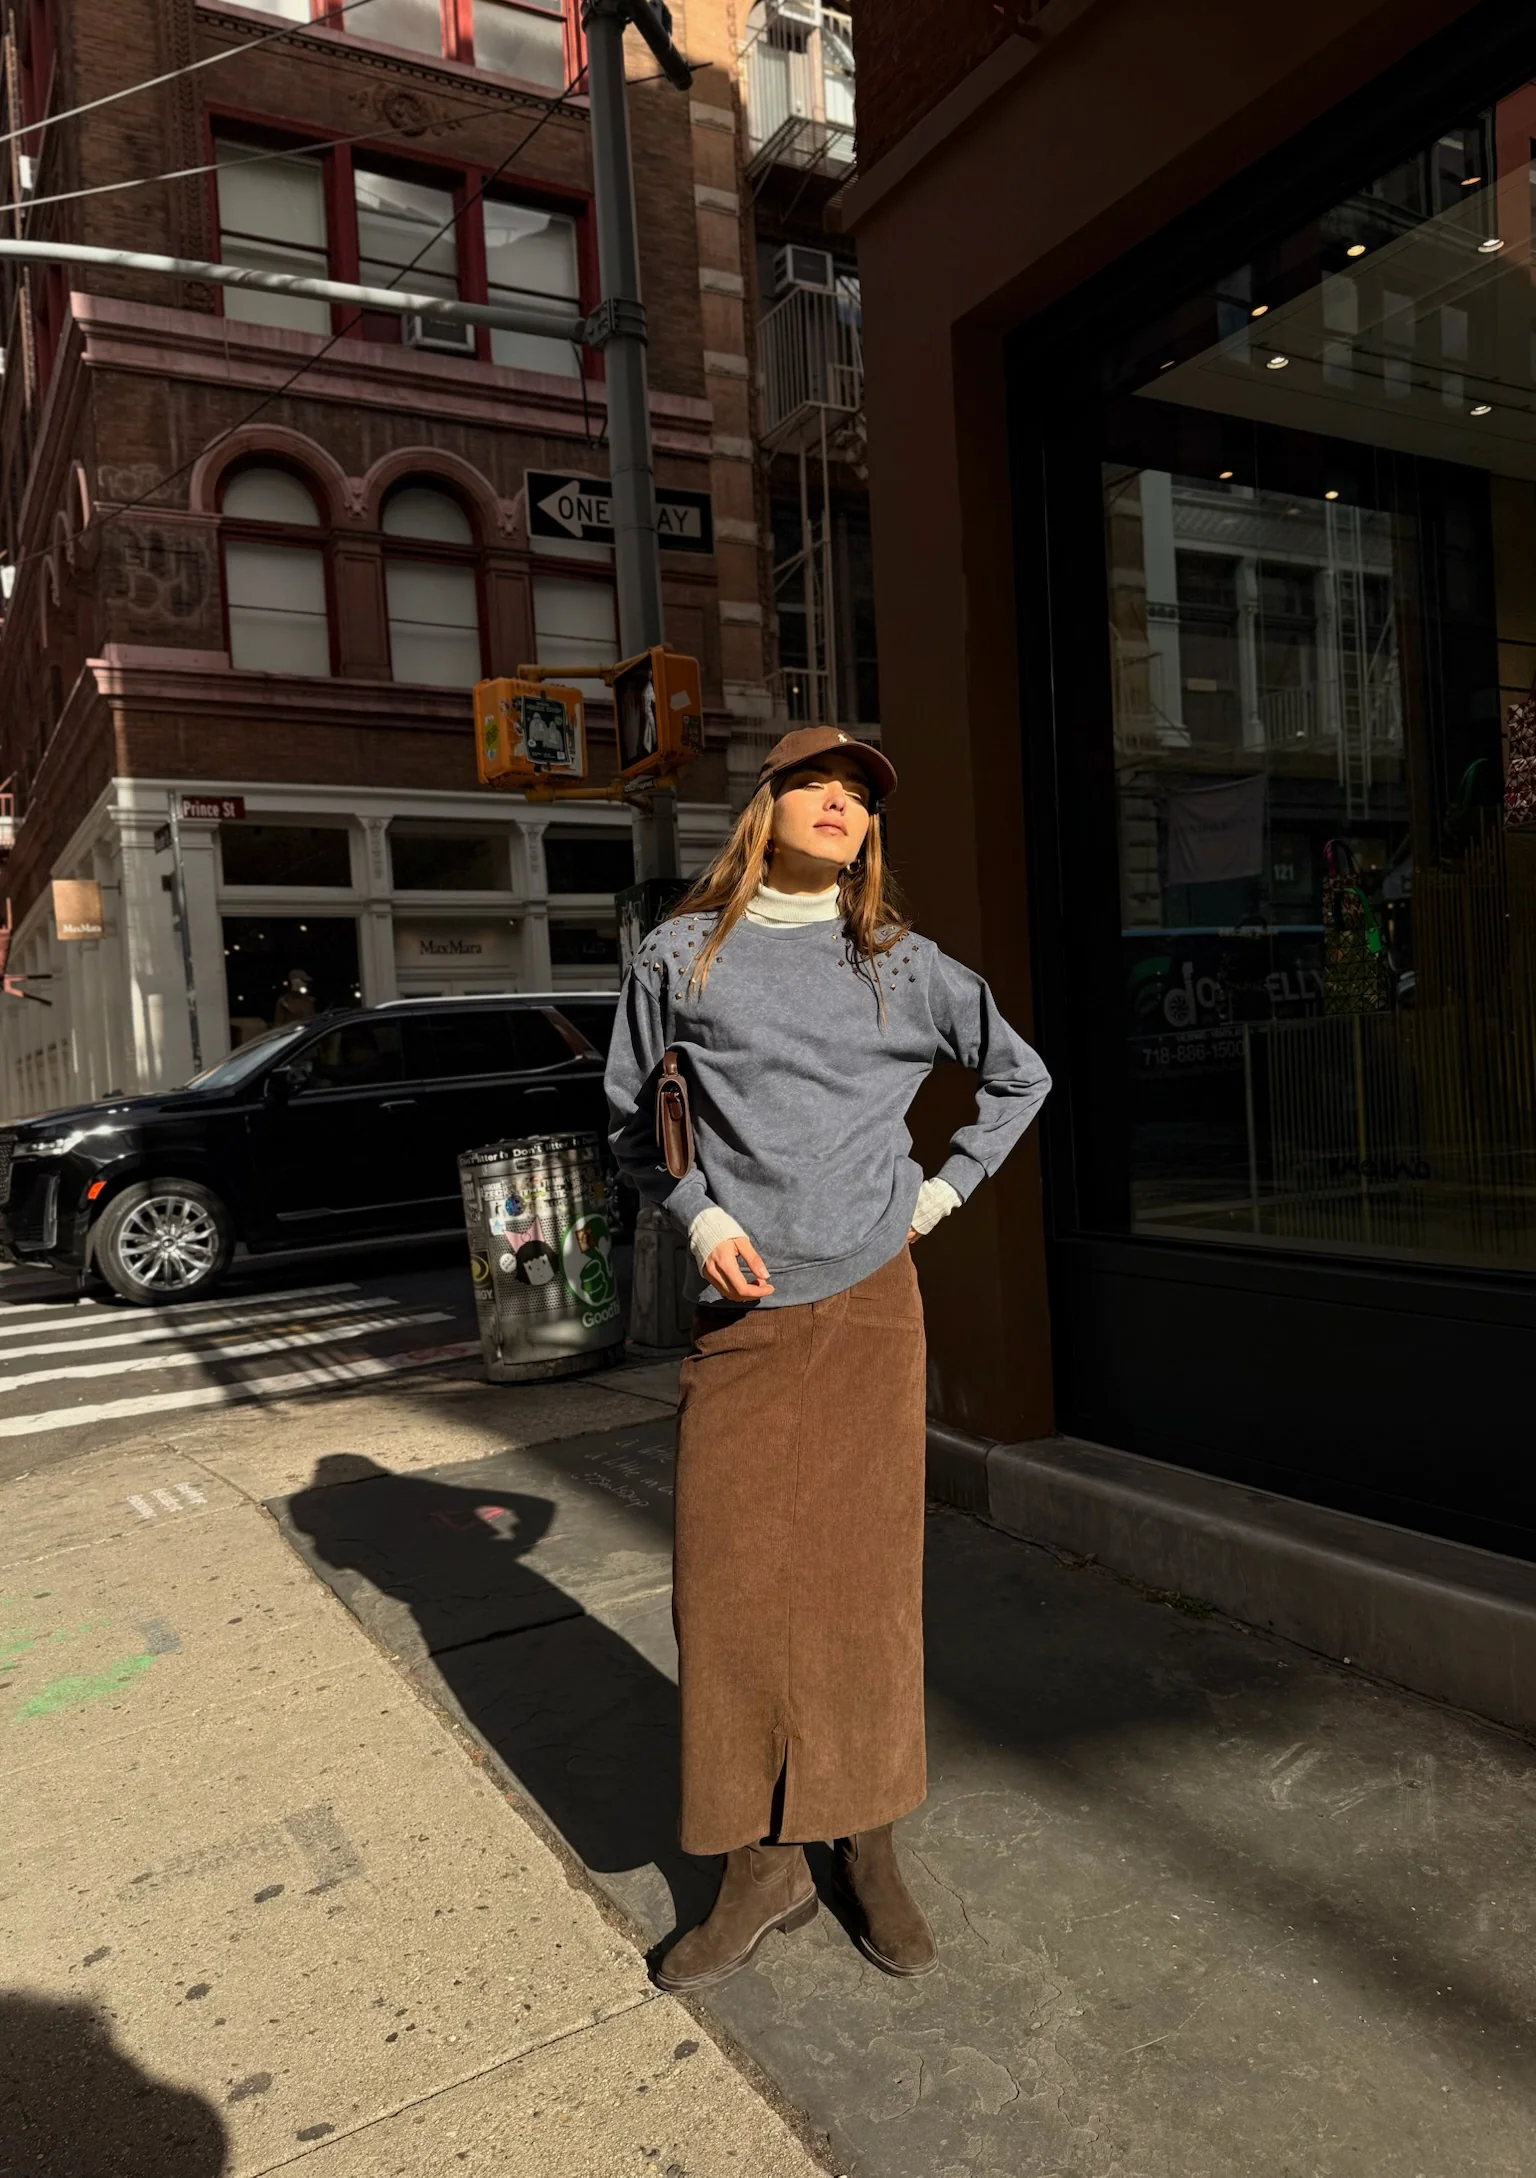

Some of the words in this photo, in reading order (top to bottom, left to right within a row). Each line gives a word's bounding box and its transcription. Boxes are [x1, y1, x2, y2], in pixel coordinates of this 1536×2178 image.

[558, 495, 611, 524] ONE
[656, 507, 689, 533] AY
[182, 800, 220, 818] Prince
[222, 801, 236, 818] St
[1273, 863, 1295, 882] 121
[62, 923, 102, 934] MaxMara
[420, 939, 483, 955] MaxMara
[512, 1144, 542, 1159] Don't
